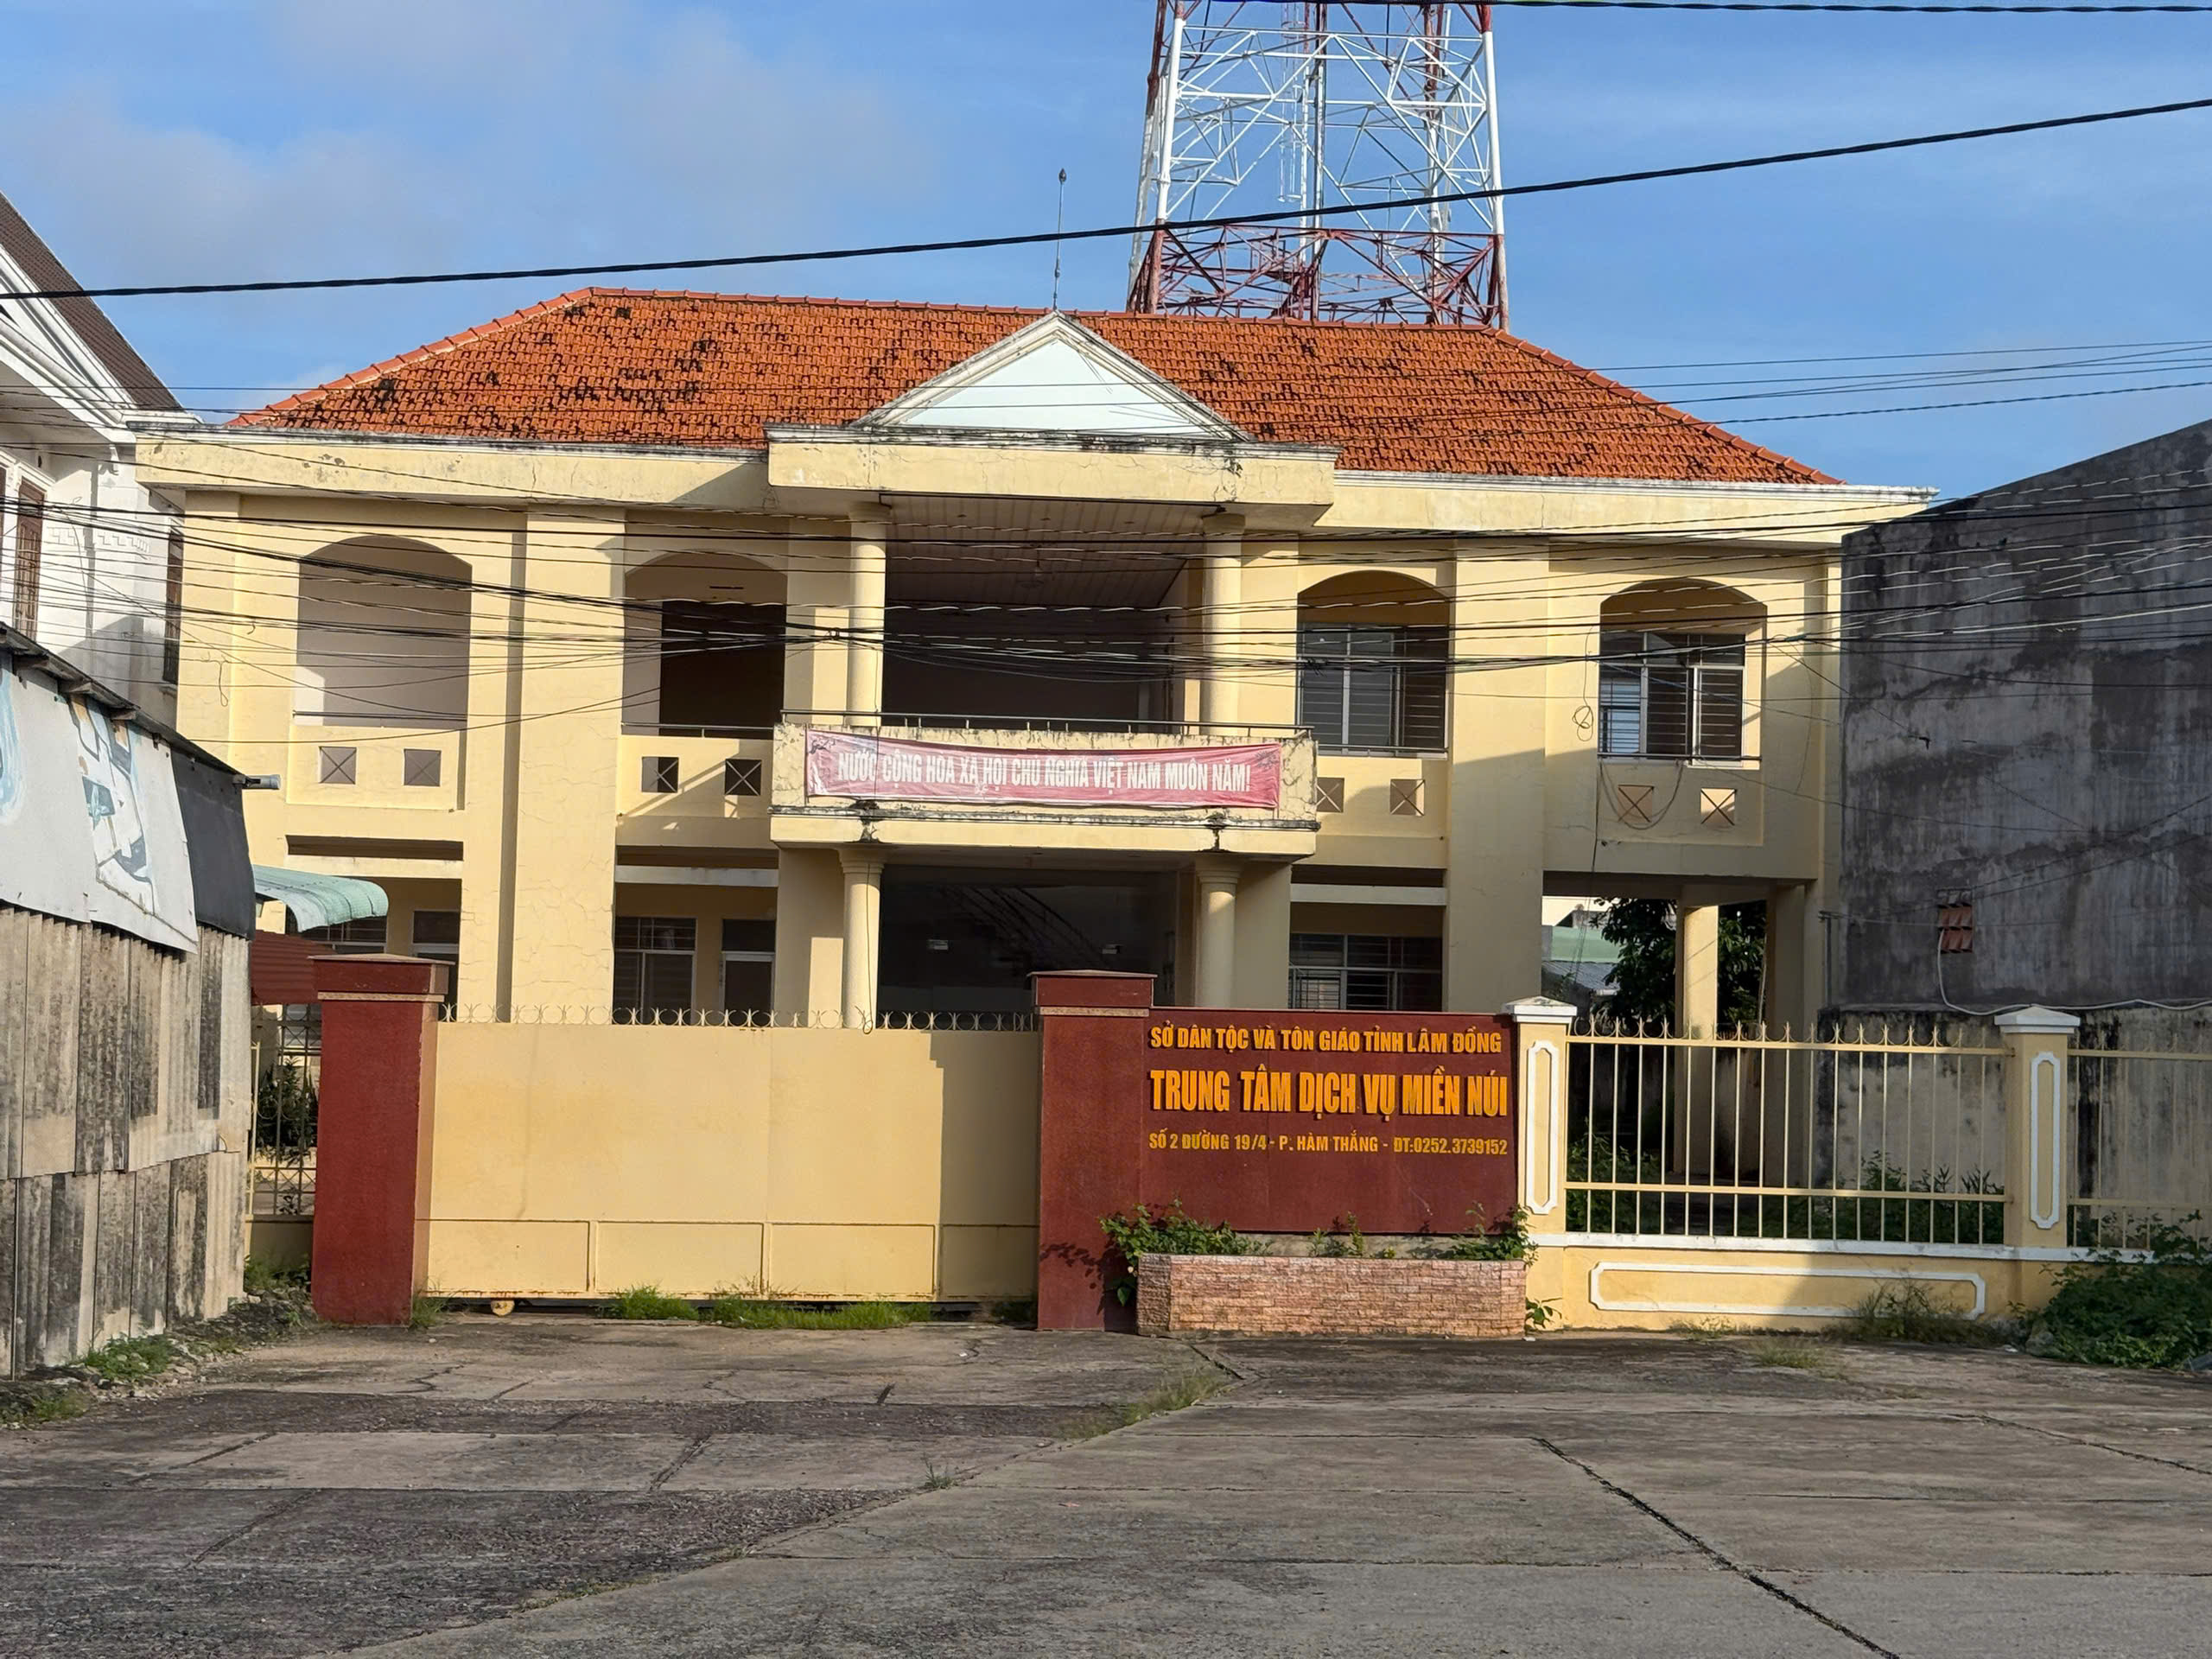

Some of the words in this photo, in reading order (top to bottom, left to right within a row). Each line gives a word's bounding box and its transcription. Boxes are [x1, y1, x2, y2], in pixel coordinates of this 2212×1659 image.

[883, 750, 922, 788] CỘNG
[1093, 758, 1123, 795] VIỆT
[1127, 761, 1160, 789] NAM
[1165, 758, 1208, 791] MUÔN
[1212, 758, 1251, 792] NĂM!
[1151, 1020, 1173, 1047] SỞ
[1178, 1025, 1211, 1048] DÂN
[1216, 1025, 1249, 1052] TỘC
[1253, 1025, 1275, 1050] VÀ
[1281, 1026, 1313, 1050] TÔN
[1319, 1027, 1360, 1052] GIÁO
[1363, 1025, 1403, 1052] TỈNH
[1407, 1027, 1447, 1052] LÂM
[1150, 1070, 1230, 1112] TRUNG
[1240, 1064, 1292, 1112] TÂM
[1299, 1071, 1356, 1119] DỊCH
[1363, 1074, 1396, 1122] VỤ
[1402, 1065, 1460, 1115] MIỀN
[1467, 1070, 1508, 1116] NÚI
[1149, 1128, 1168, 1149] SỐ
[1170, 1134, 1178, 1148] 2
[1182, 1129, 1230, 1149] ĐƯỜNG
[1234, 1135, 1267, 1150] 19/4
[1297, 1133, 1328, 1152] HÀM
[1332, 1129, 1378, 1152] THẮNG
